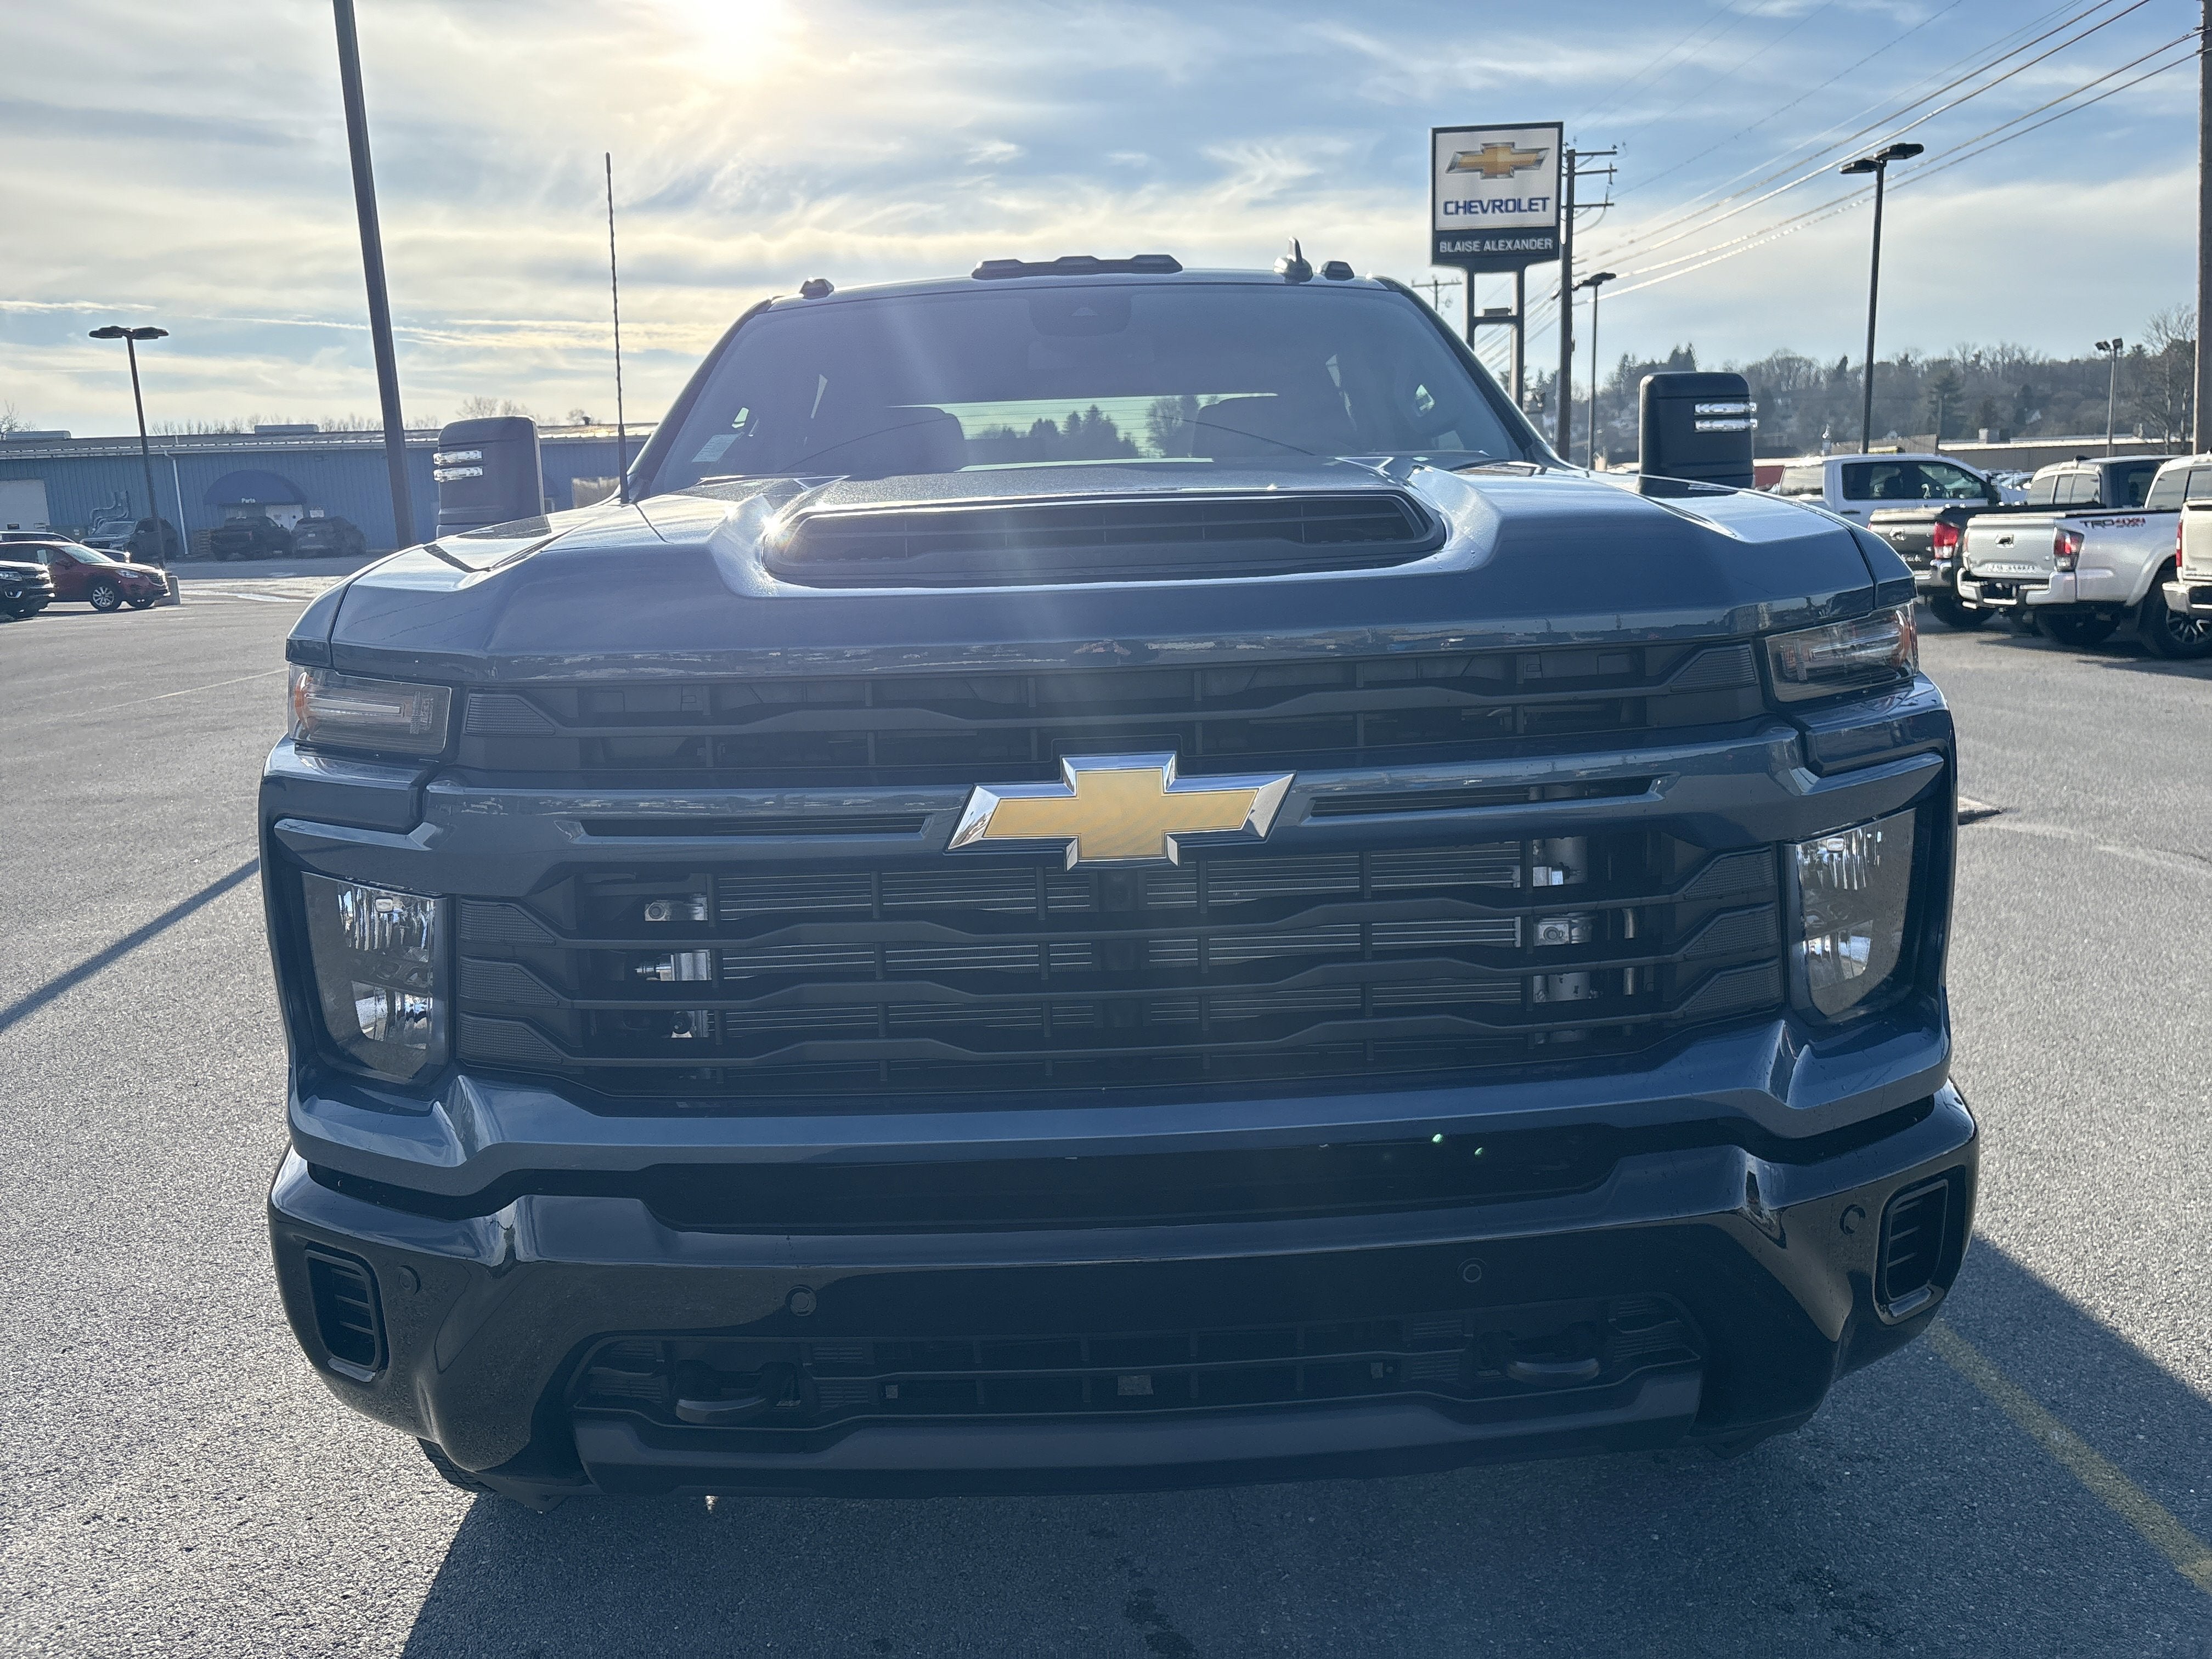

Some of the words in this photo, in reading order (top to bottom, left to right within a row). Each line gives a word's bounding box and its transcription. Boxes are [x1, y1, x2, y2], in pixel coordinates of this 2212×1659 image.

[1443, 196, 1550, 216] CHEVROLET
[1439, 240, 1481, 253] BLAISE
[1482, 237, 1554, 252] ALEXANDER
